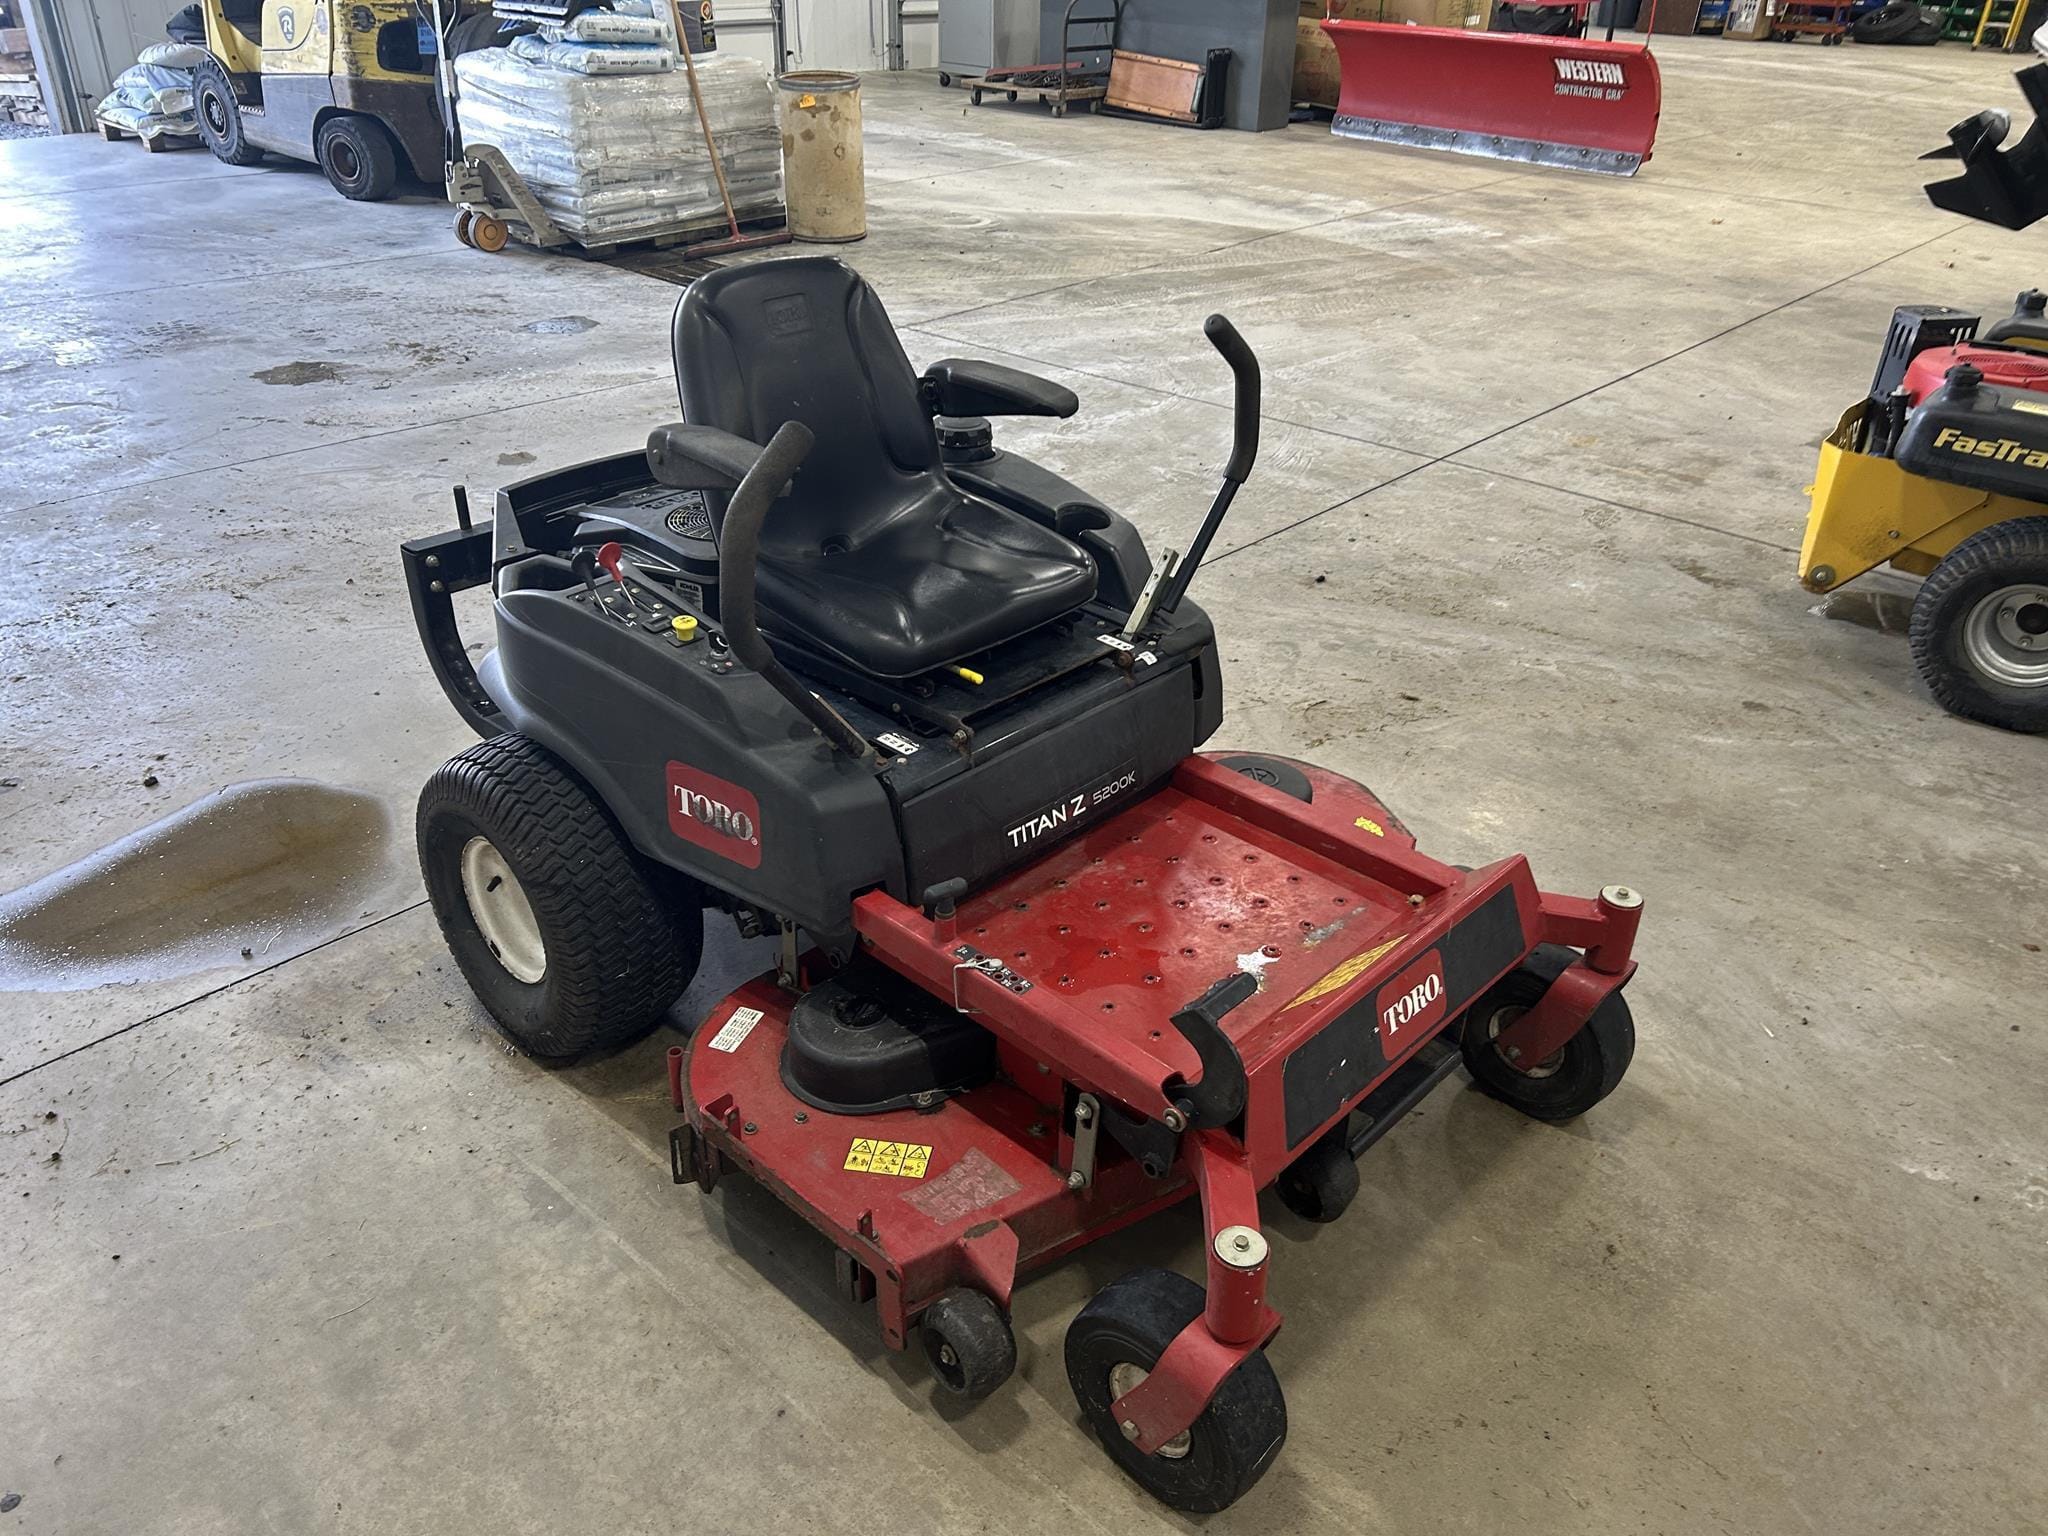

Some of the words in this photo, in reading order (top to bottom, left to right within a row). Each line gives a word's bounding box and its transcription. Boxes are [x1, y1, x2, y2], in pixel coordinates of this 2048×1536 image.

[1554, 58, 1624, 85] WESTERN
[1554, 83, 1603, 100] CONTRACTOR
[1605, 88, 1625, 101] GRA
[1933, 427, 2048, 470] FasTra
[673, 784, 754, 841] TORO
[1007, 804, 1067, 848] TITAN
[1070, 793, 1087, 817] Z
[1092, 770, 1136, 806] 5200K
[1383, 973, 1441, 1036] TORO
